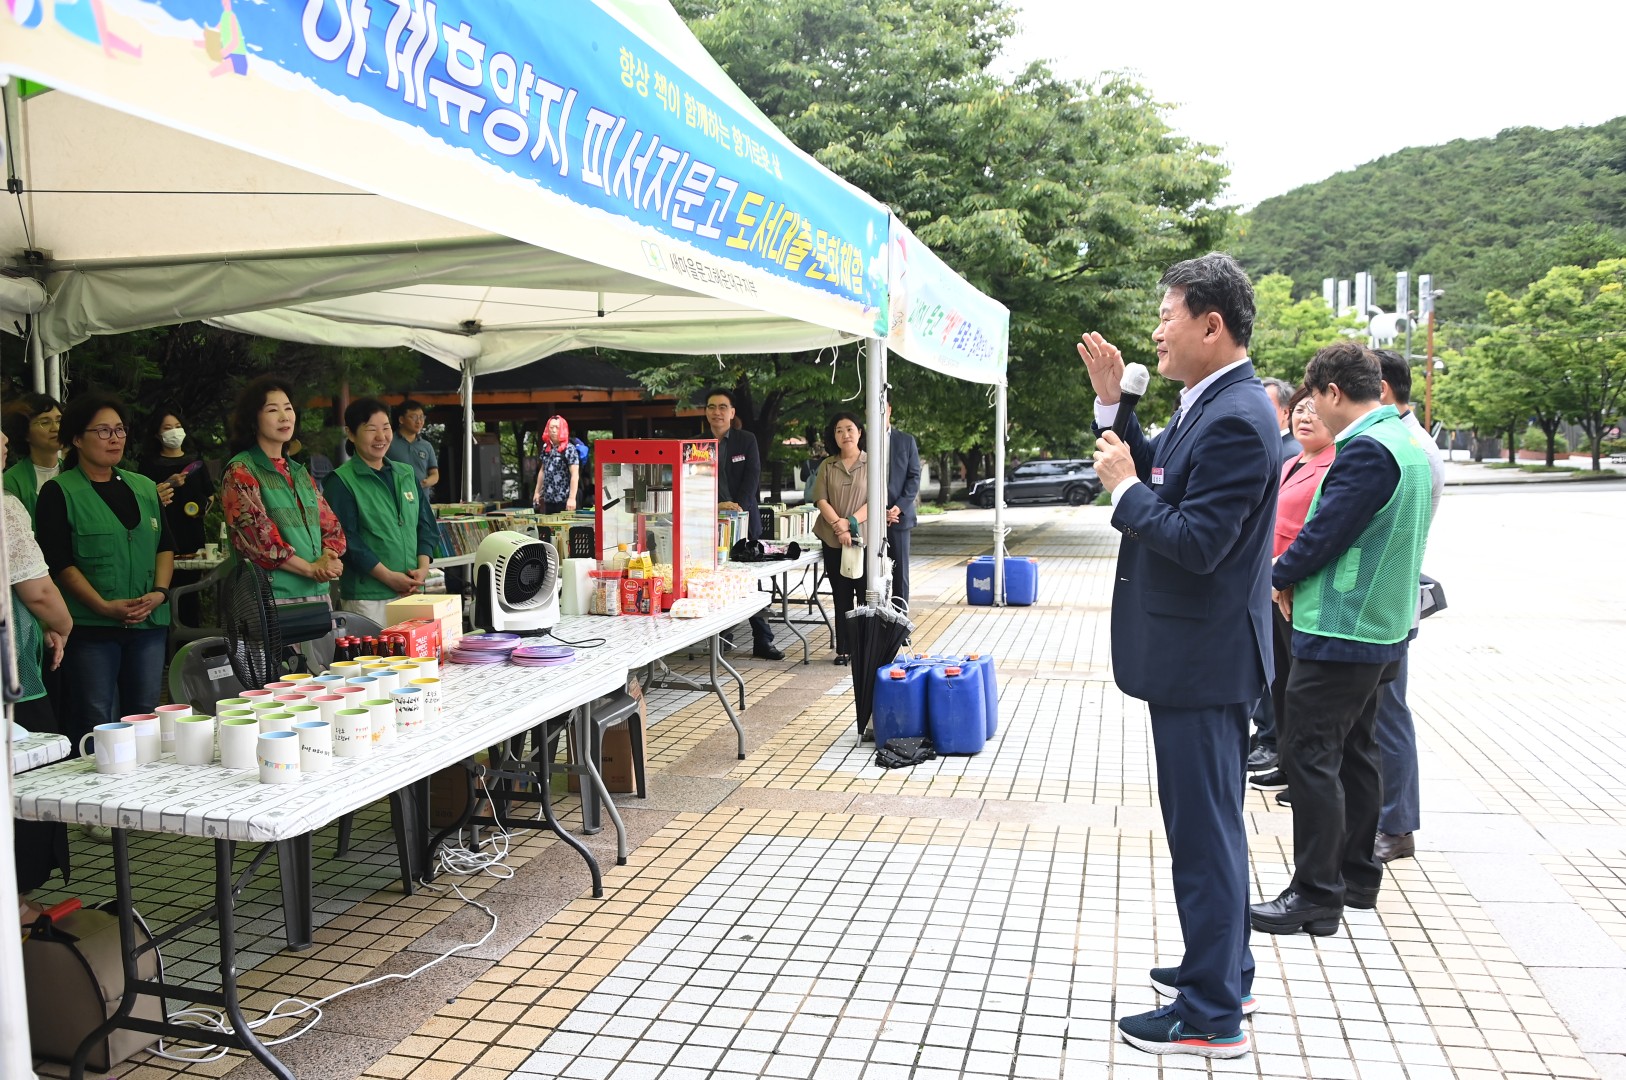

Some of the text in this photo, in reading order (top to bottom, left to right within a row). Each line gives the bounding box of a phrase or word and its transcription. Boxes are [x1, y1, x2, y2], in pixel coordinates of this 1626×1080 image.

[581, 107, 739, 239] 피서지문고
[619, 45, 650, 98] 항상
[653, 70, 680, 119] 책이
[684, 91, 730, 150] 함께하는
[731, 125, 773, 174] 향기로운
